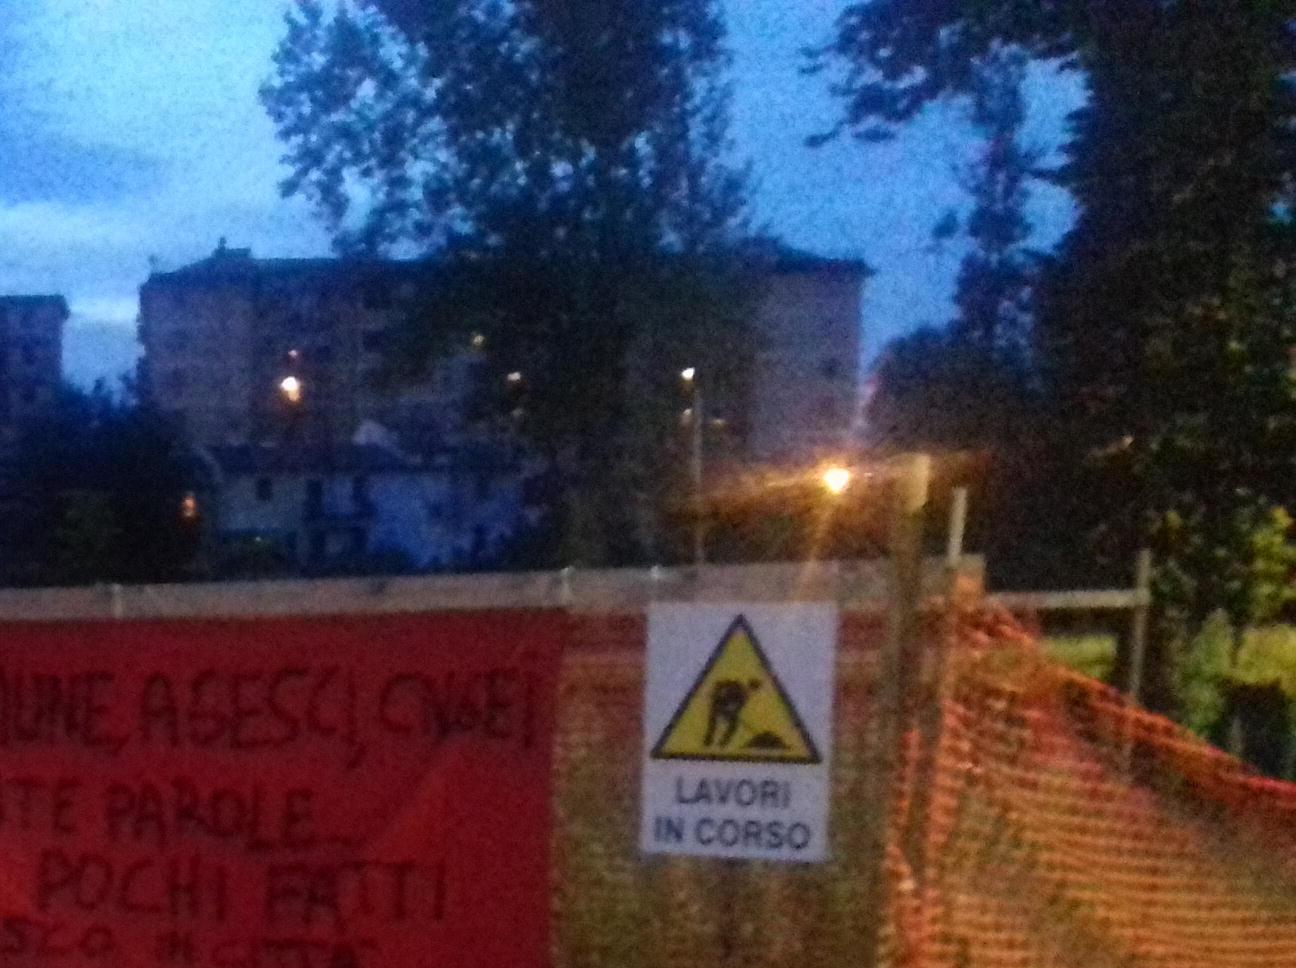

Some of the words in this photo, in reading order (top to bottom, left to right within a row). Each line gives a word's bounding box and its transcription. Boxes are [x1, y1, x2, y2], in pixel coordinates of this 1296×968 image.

[675, 774, 792, 810] LAVORI
[654, 815, 686, 845] IN
[695, 816, 811, 851] CORSO
[38, 846, 226, 924] POCHI
[265, 858, 447, 932] FATTI
